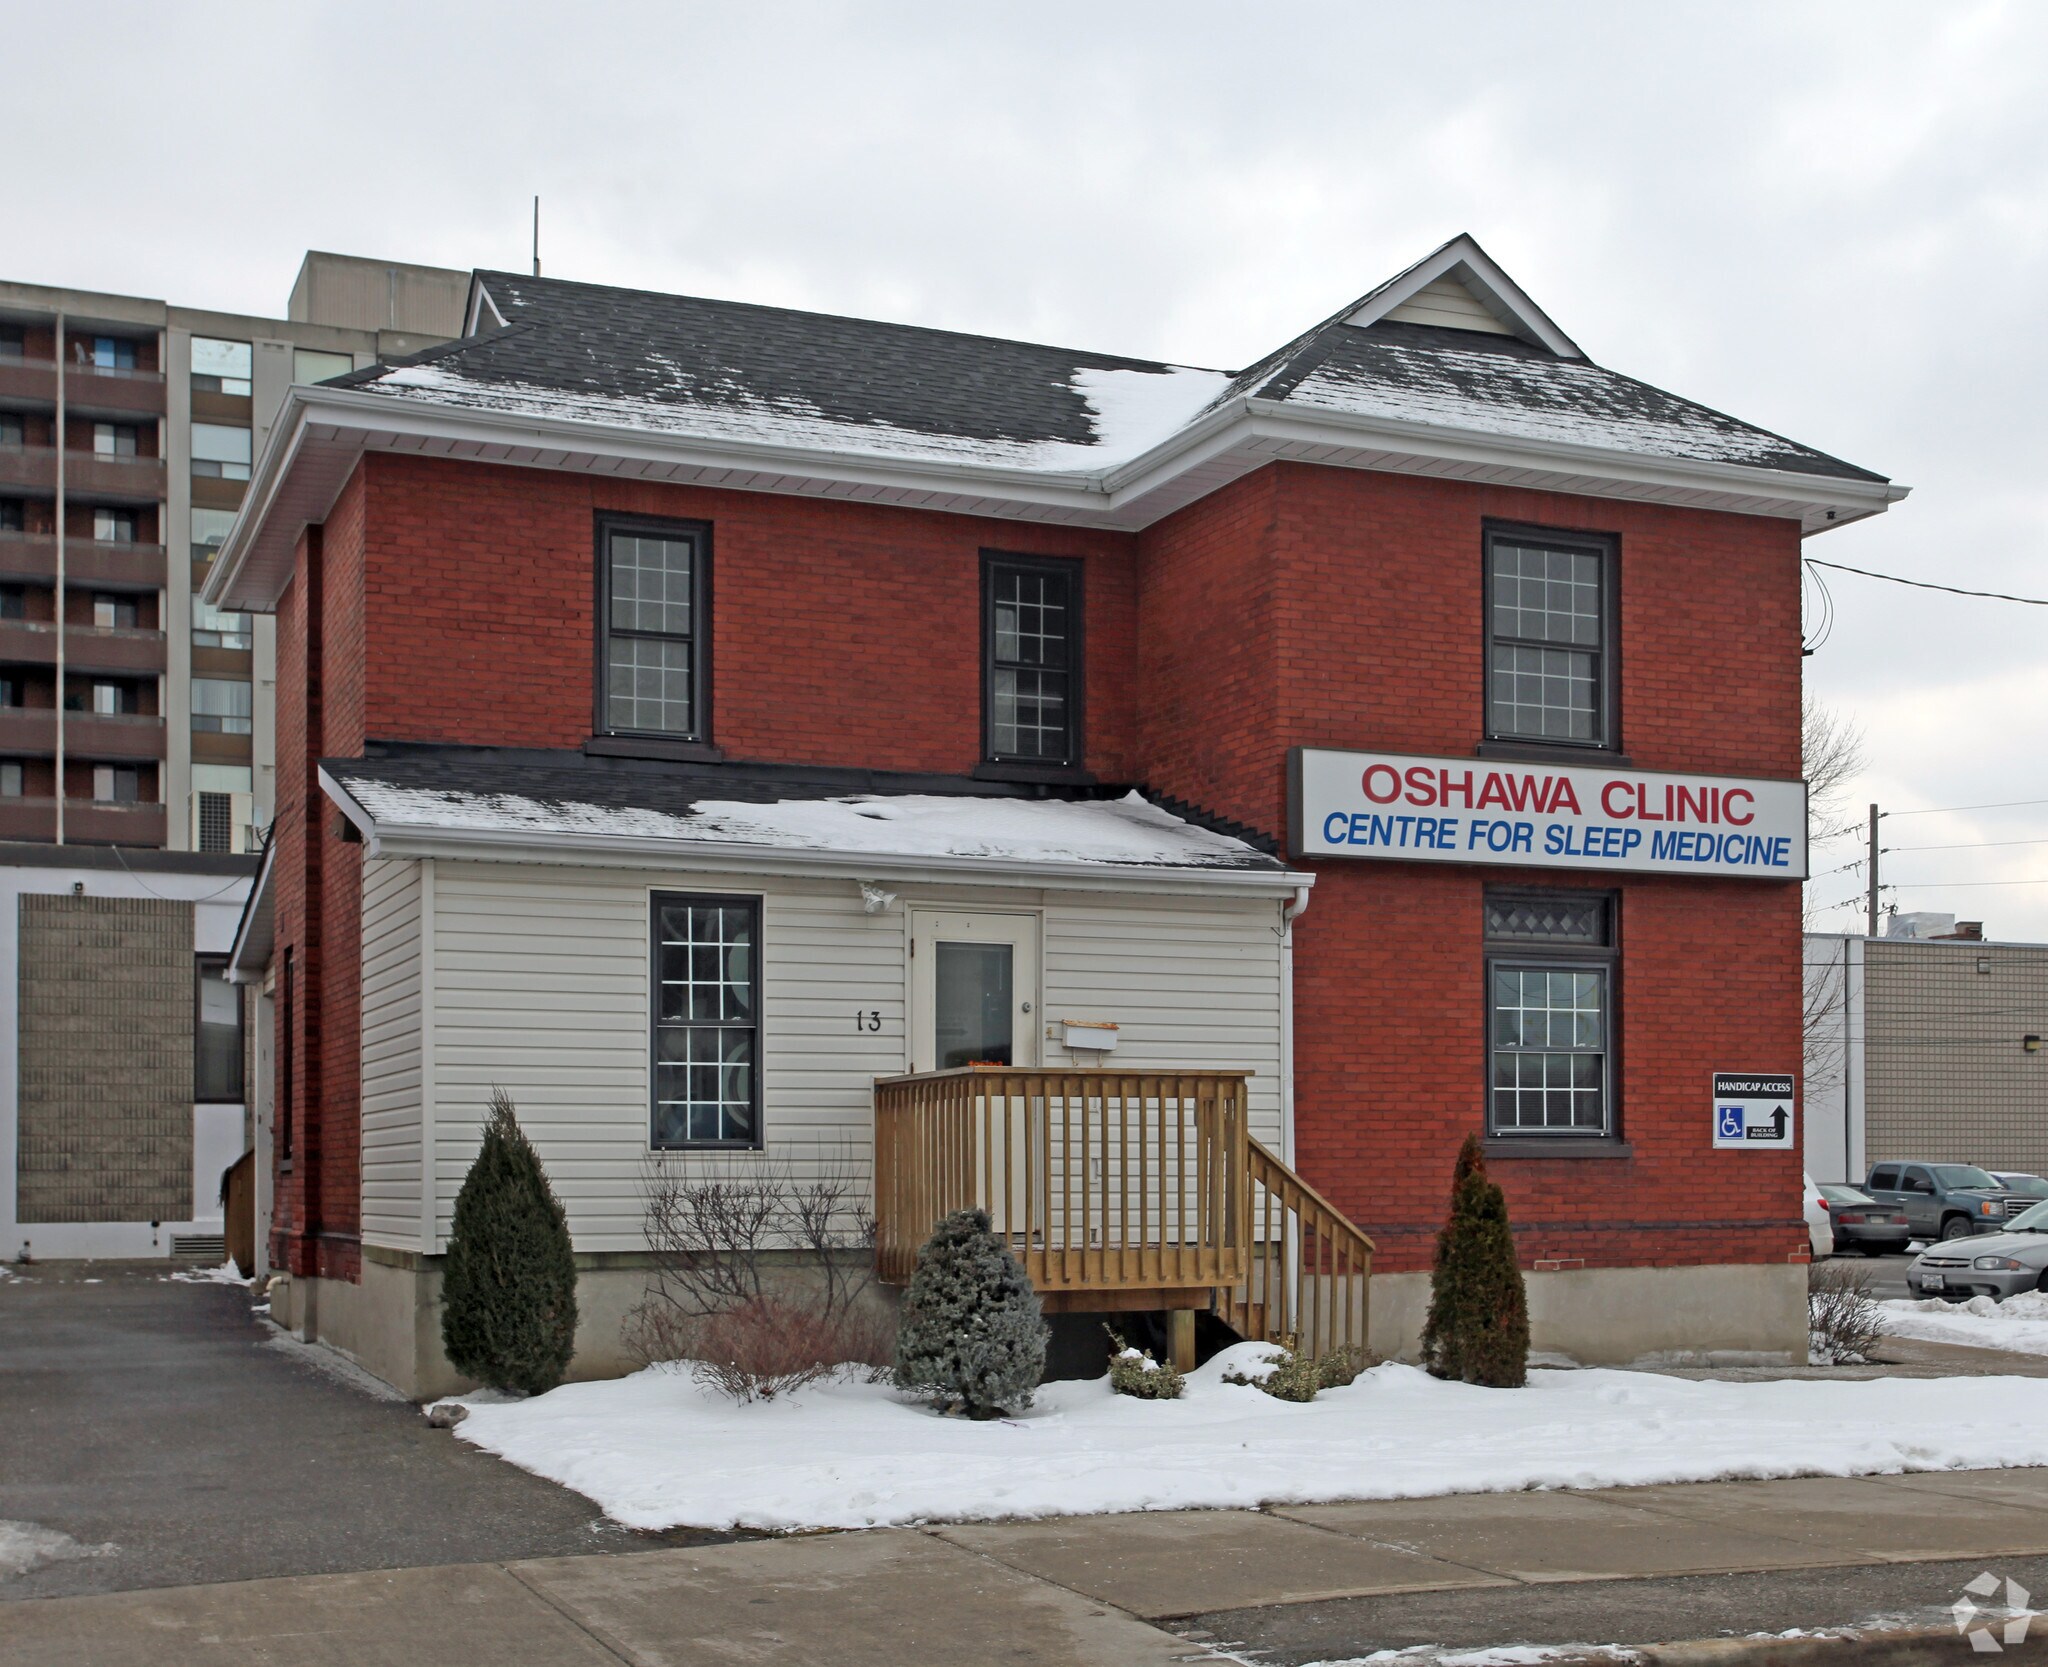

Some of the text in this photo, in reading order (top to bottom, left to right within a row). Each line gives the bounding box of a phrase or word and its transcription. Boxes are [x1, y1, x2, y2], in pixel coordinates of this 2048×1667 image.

[1361, 764, 1755, 826] OSHAWA CLINIC
[1322, 811, 1792, 867] CENTRE FOR SLEEP MEDICINE
[856, 1010, 882, 1032] 13
[1717, 1081, 1791, 1092] HANDICAP ACCESS
